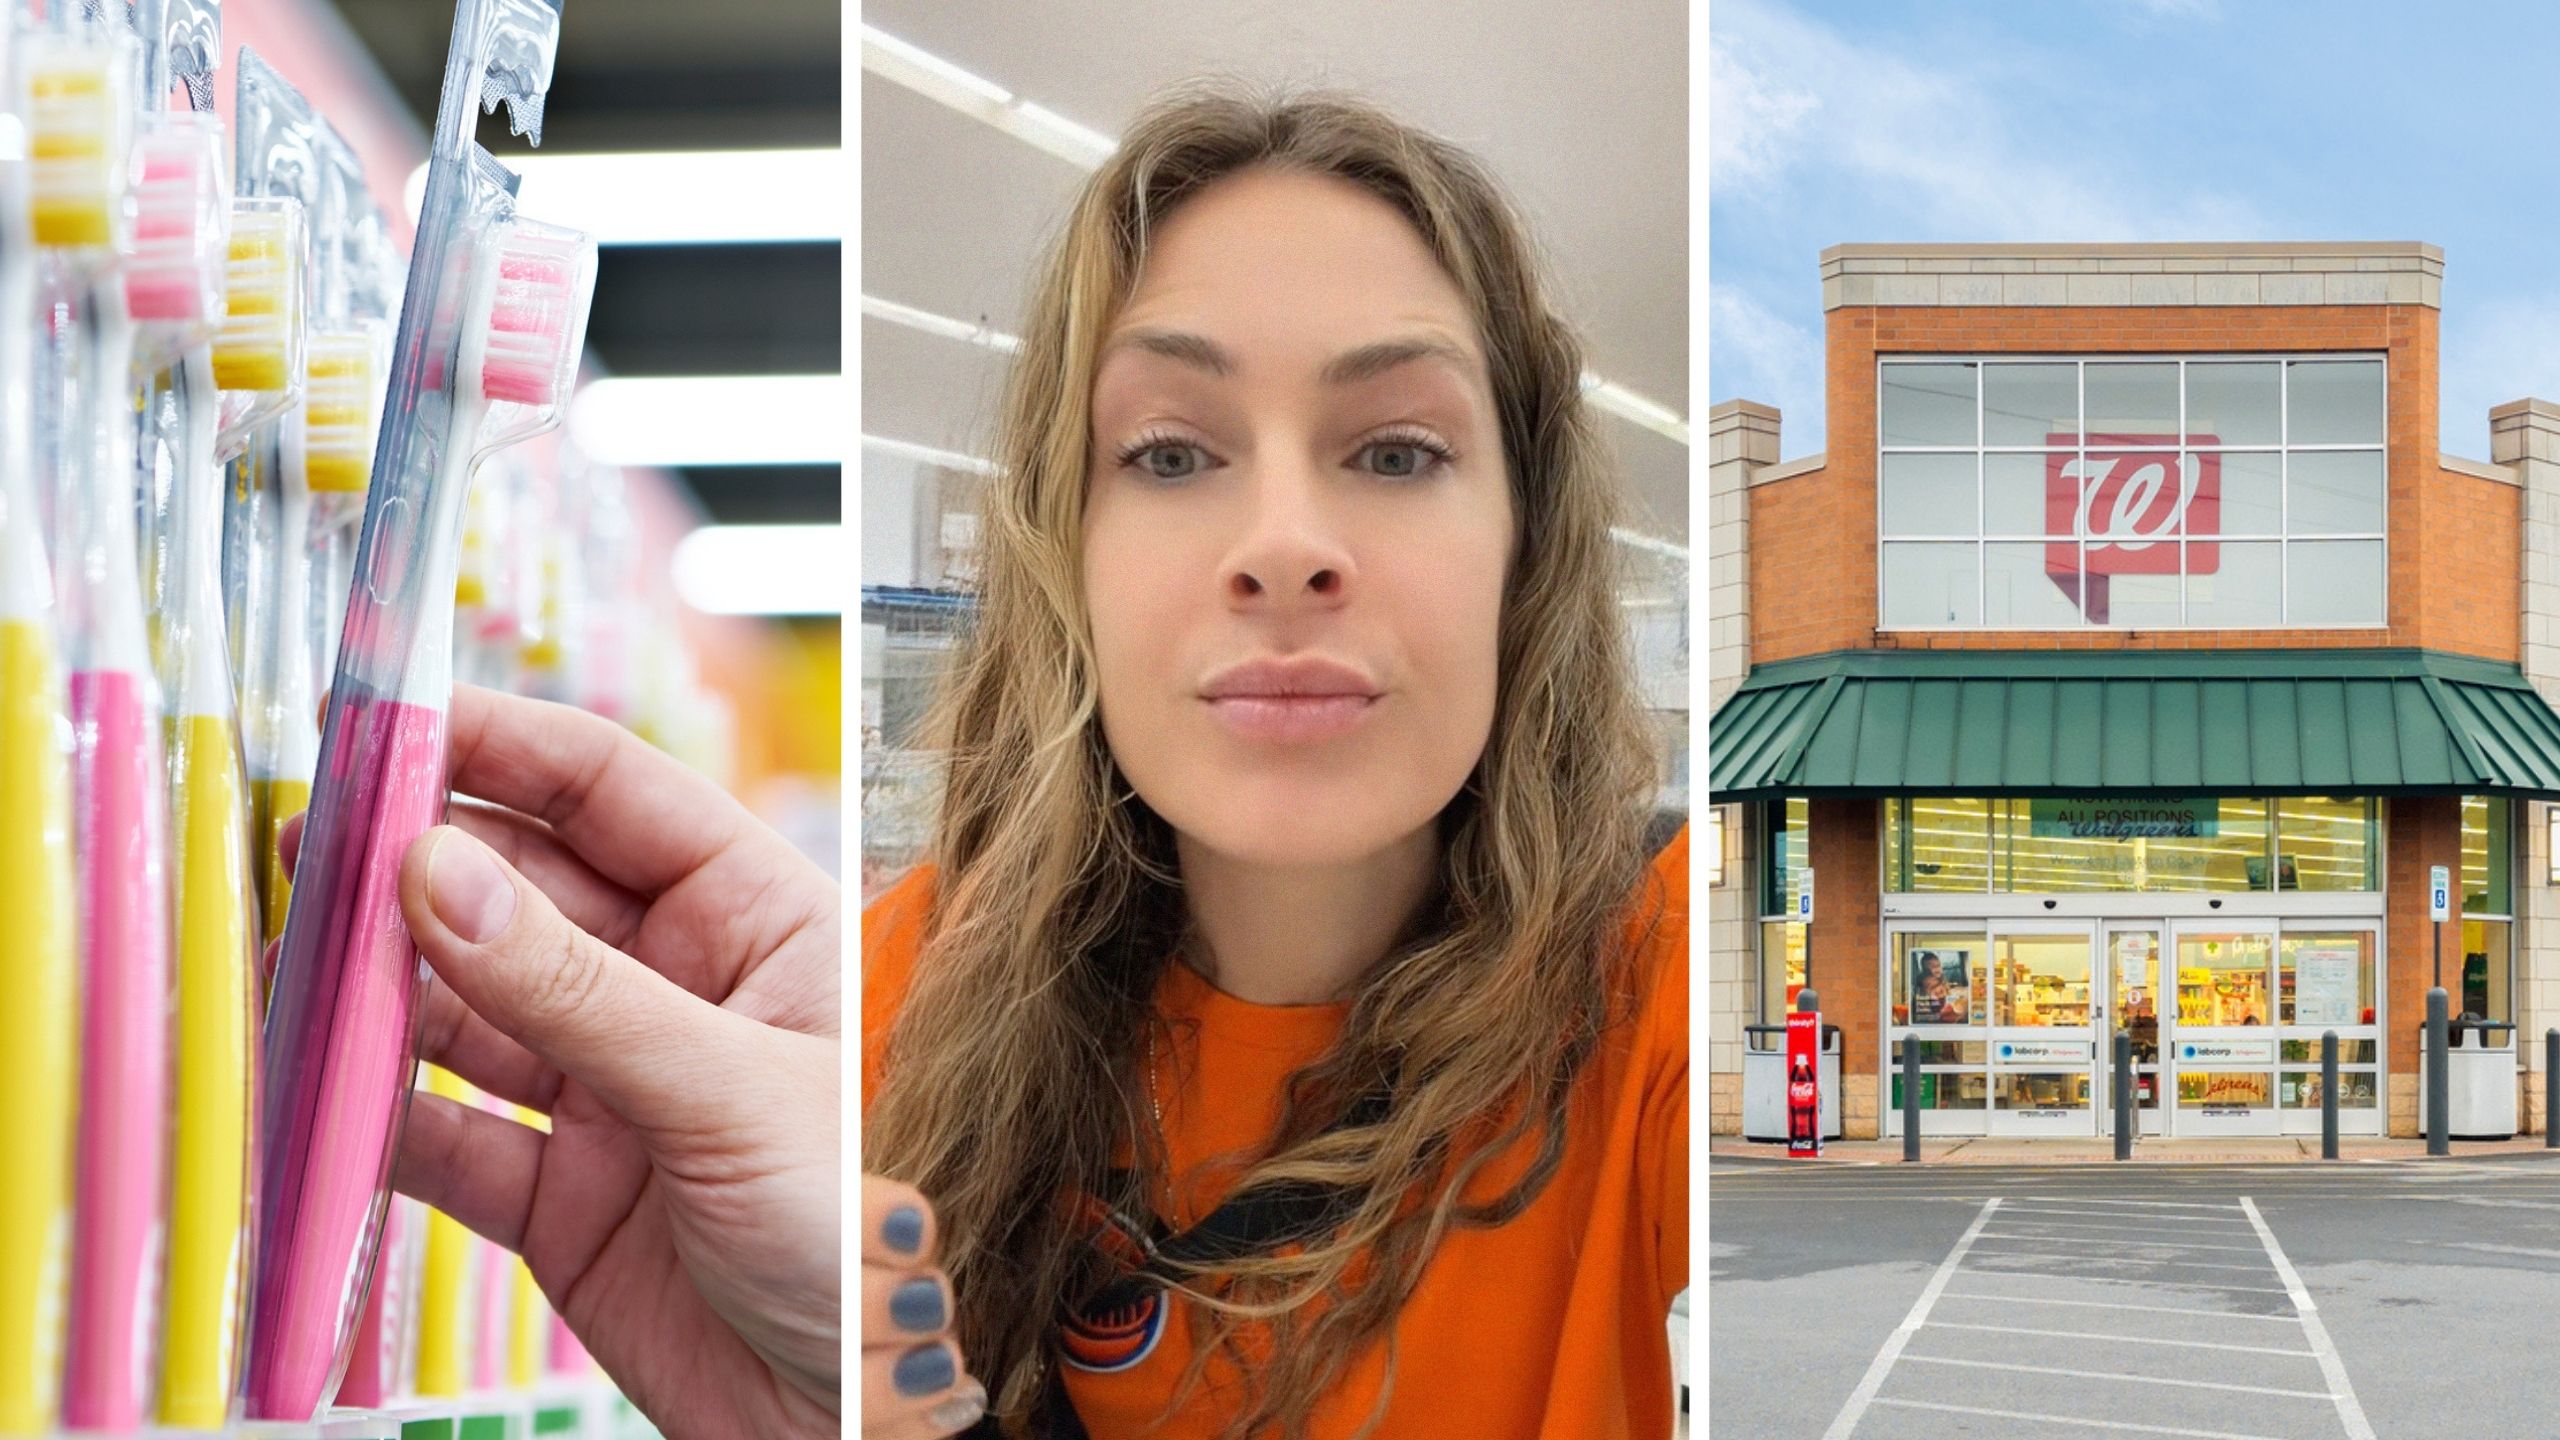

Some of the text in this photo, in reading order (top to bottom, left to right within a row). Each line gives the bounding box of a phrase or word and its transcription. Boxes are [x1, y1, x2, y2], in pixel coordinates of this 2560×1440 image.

[2057, 809, 2195, 823] ALL POSITIONS
[2069, 820, 2199, 843] Walgreens
